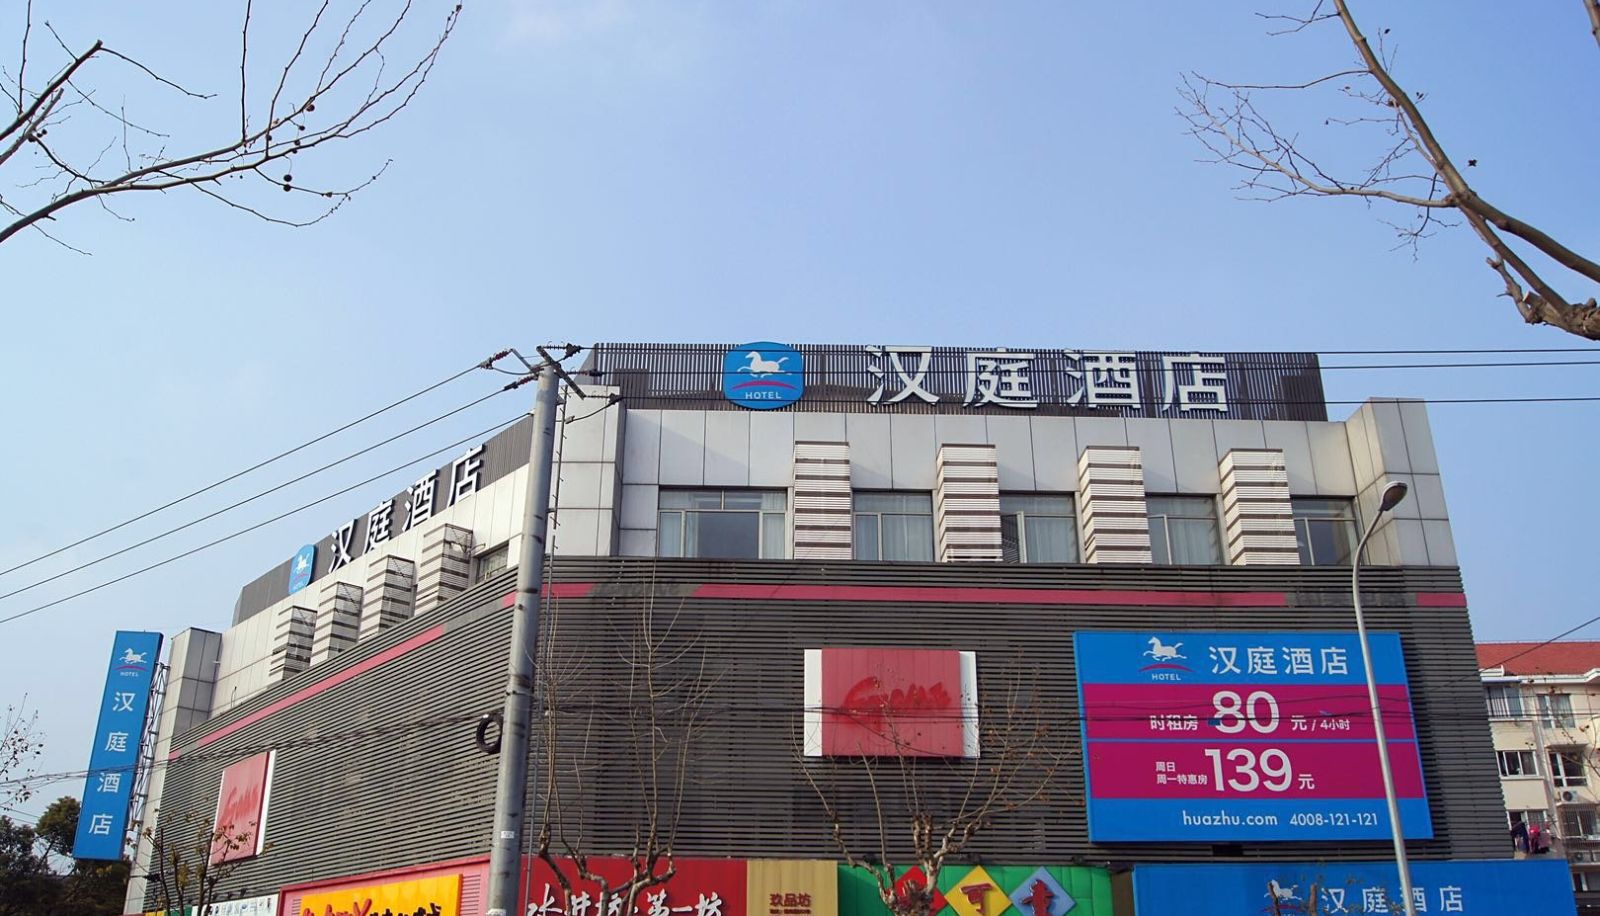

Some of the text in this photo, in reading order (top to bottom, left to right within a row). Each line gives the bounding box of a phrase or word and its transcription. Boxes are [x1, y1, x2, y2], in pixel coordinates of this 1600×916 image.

[865, 345, 1228, 412] 汉庭酒店
[745, 391, 782, 400] HOTEL
[328, 443, 486, 573] 汉庭酒店
[1208, 645, 1349, 675] 汉庭酒店
[1151, 673, 1182, 681] HOTEL
[1149, 714, 1198, 731] 时租房
[1211, 690, 1280, 735] 80
[1290, 714, 1308, 730] 元
[1319, 718, 1351, 731] 4小时
[88, 691, 137, 835] 汉庭酒店
[1155, 761, 1176, 772] 周日
[1204, 748, 1316, 793] 139 元
[1182, 810, 1379, 827] huazhu.com 4008-121-121
[1321, 885, 1464, 914] 汉庭酒店
